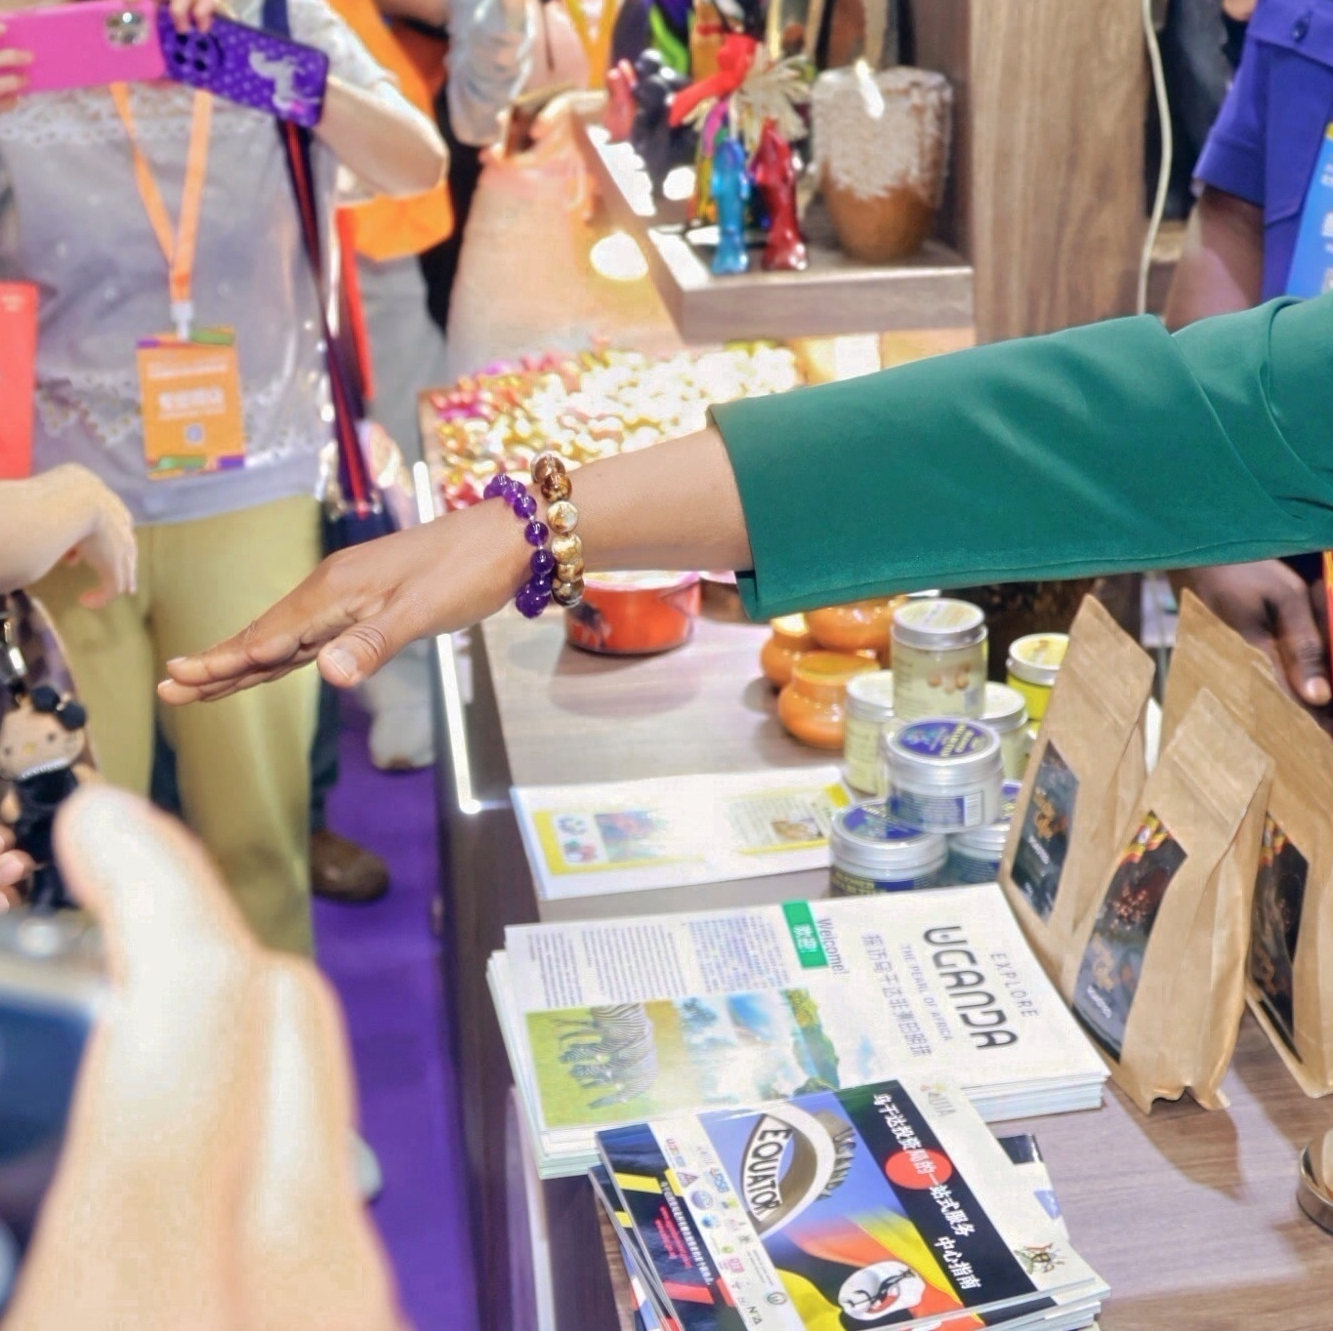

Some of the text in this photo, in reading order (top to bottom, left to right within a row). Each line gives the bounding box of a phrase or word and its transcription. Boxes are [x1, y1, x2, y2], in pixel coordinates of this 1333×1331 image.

[817, 918, 850, 975] Welcome!
[923, 925, 1019, 1051] UGANDA
[990, 952, 1041, 1018] EXPLORE
[901, 942, 916, 960] THE
[910, 965, 929, 996] PEARL
[932, 1011, 954, 1043] AFRICA
[747, 1128, 794, 1217] EQUATOR
[873, 1093, 976, 1238] 乌干达投资局的一站式服务
[934, 1235, 983, 1291] 中心指南
